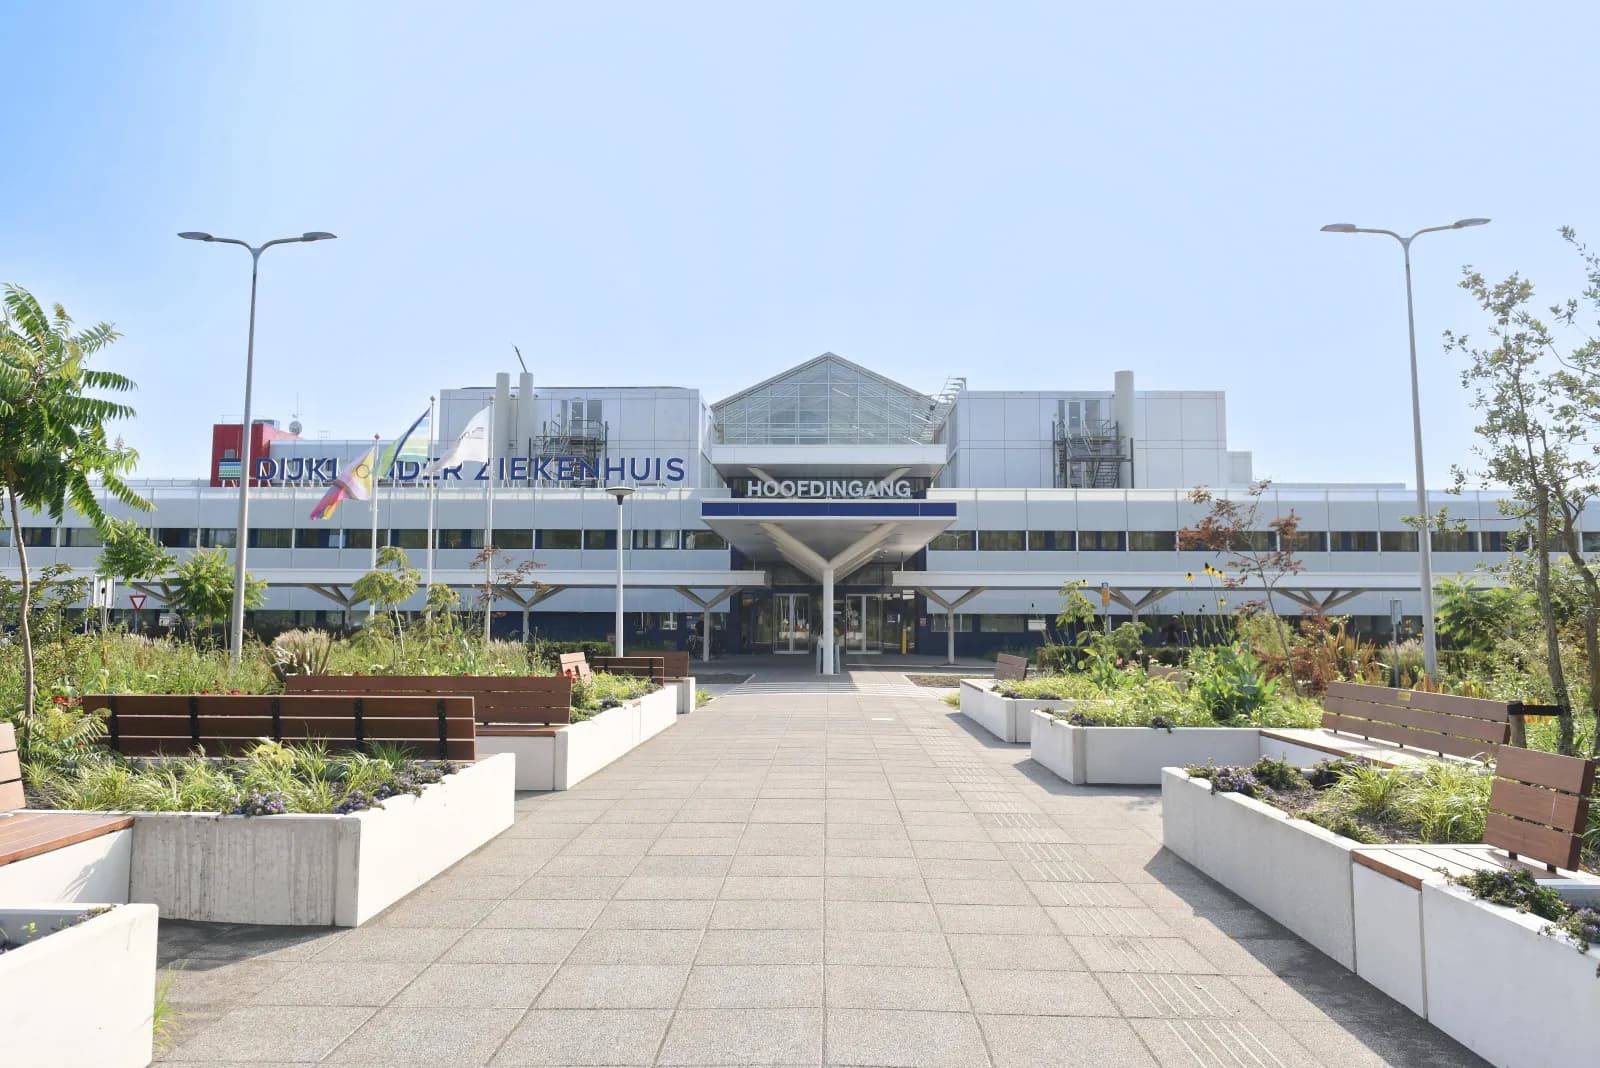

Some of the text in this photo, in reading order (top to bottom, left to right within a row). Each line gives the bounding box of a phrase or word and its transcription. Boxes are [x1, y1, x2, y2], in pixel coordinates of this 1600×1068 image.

[256, 457, 685, 481] DIJKLDR ZIEKENHUIS
[747, 480, 911, 497] HOOFDINGANG
